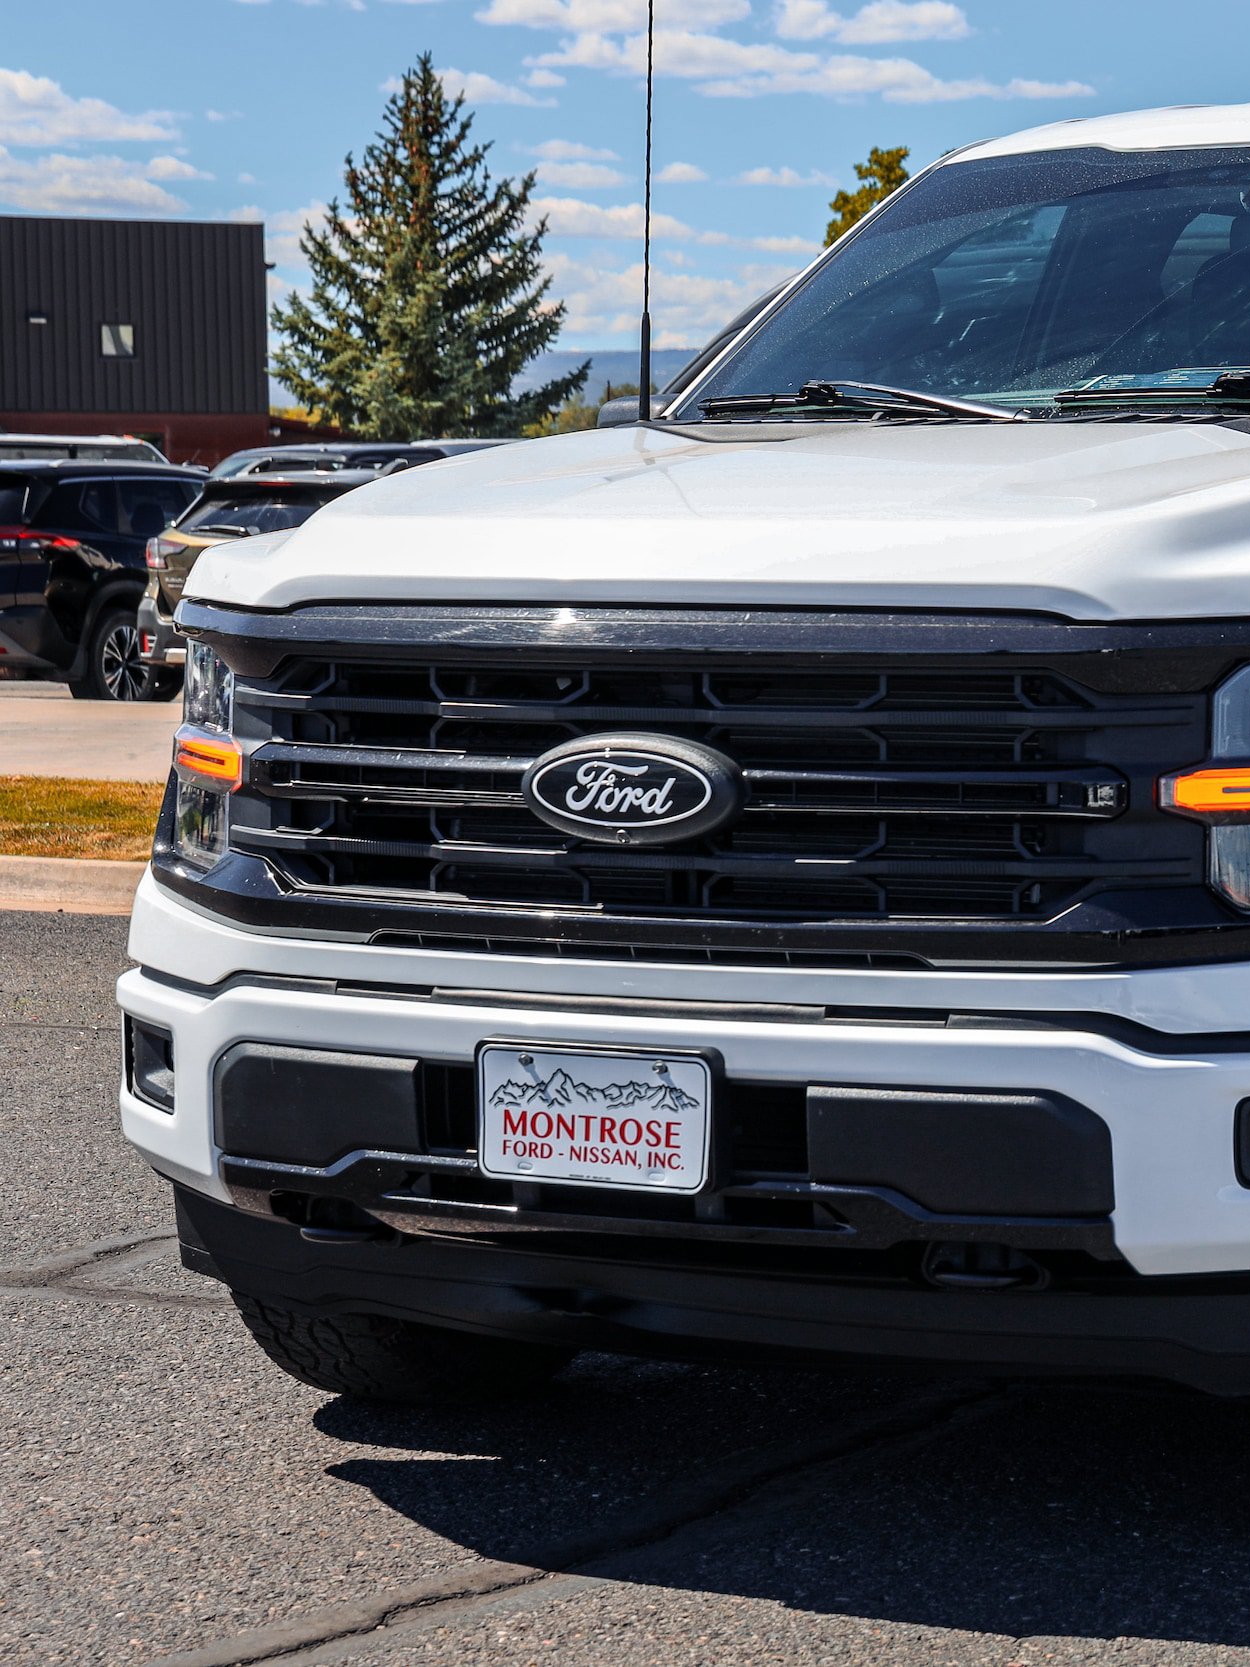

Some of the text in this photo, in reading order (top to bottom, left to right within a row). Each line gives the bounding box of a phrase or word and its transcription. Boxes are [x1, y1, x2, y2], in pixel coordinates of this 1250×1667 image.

[565, 760, 677, 815] Ford
[503, 1108, 683, 1149] MONTROSE
[502, 1139, 553, 1159] FORD
[569, 1144, 642, 1170] NISSAN,
[647, 1151, 685, 1171] INC.
